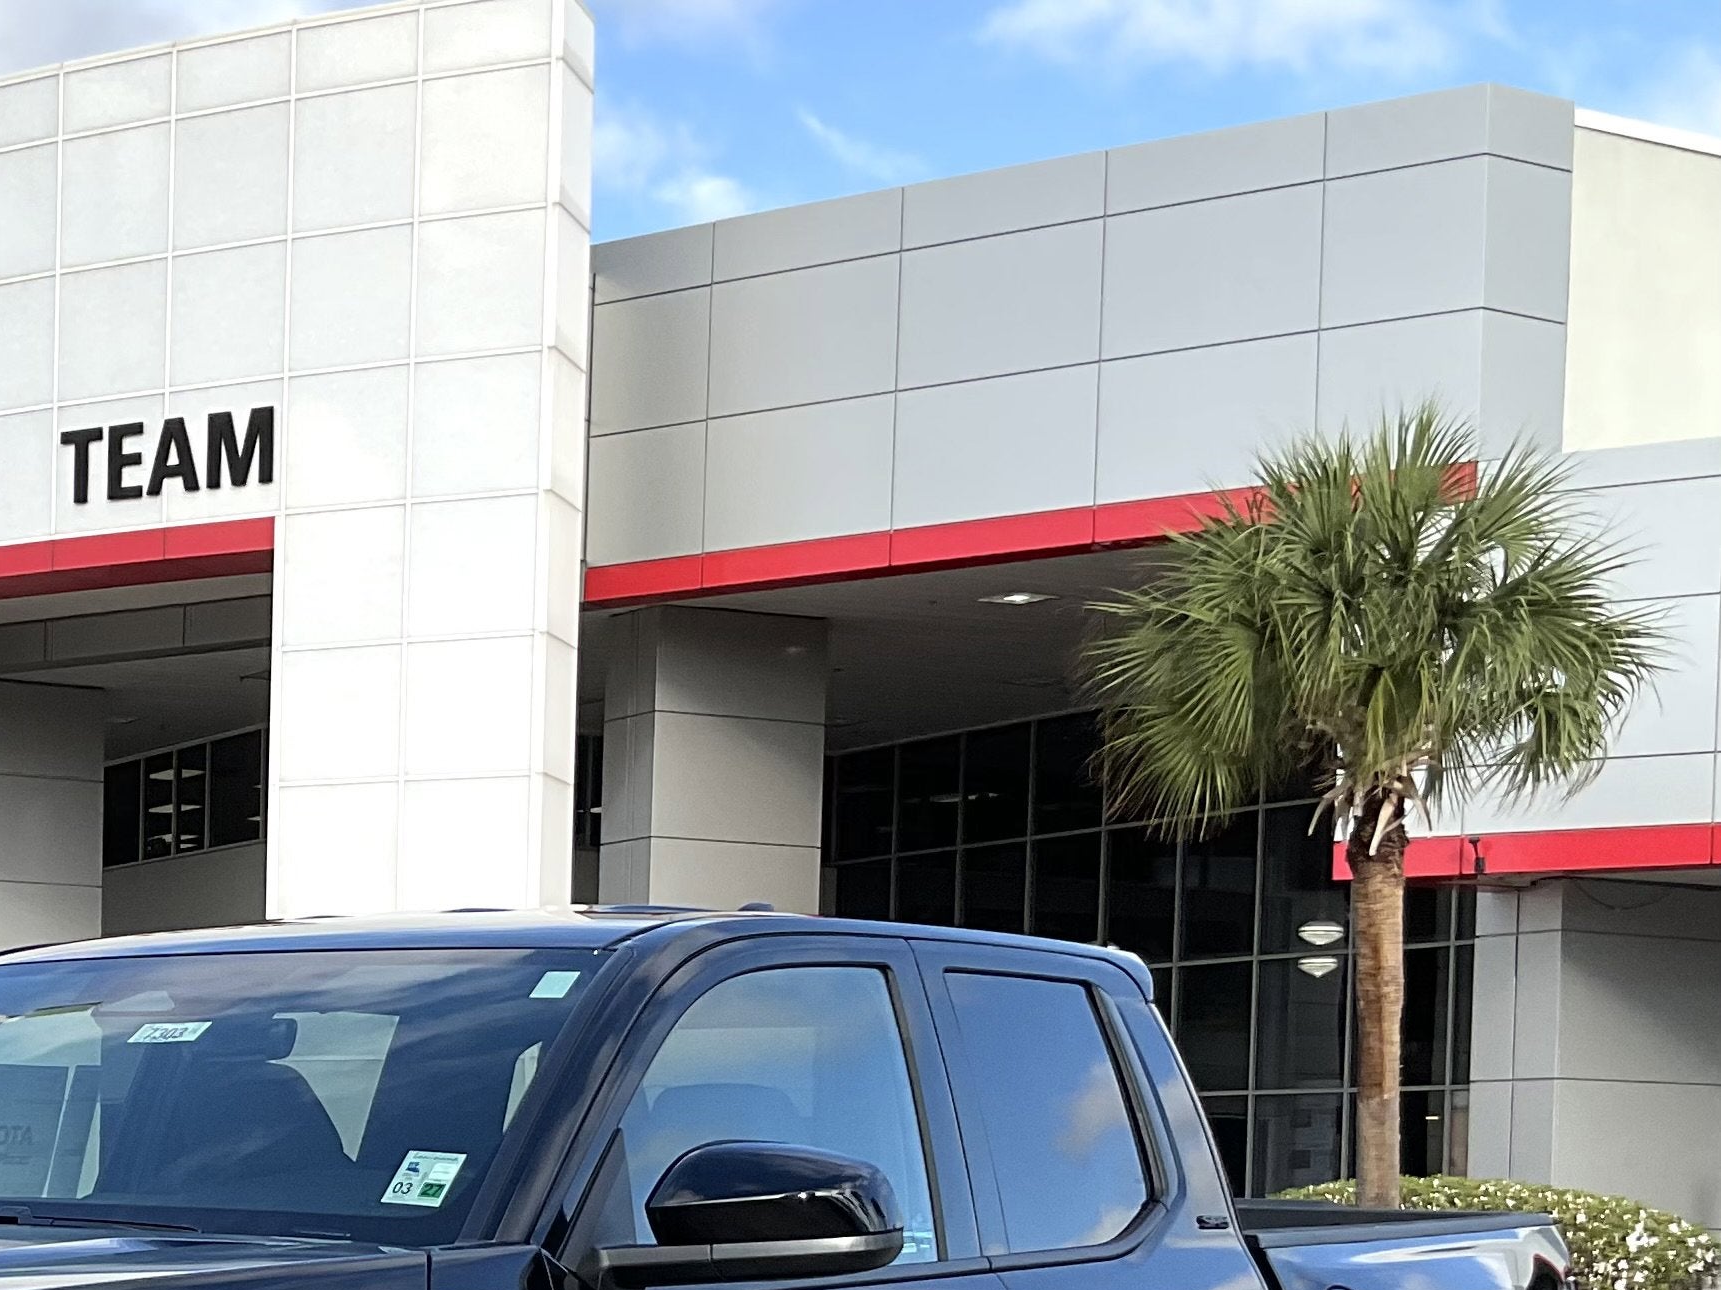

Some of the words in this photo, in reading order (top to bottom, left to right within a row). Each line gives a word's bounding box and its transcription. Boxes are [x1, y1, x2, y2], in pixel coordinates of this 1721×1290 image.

[61, 406, 274, 504] TEAM
[392, 1181, 414, 1195] 03
[420, 1183, 444, 1198] 27
